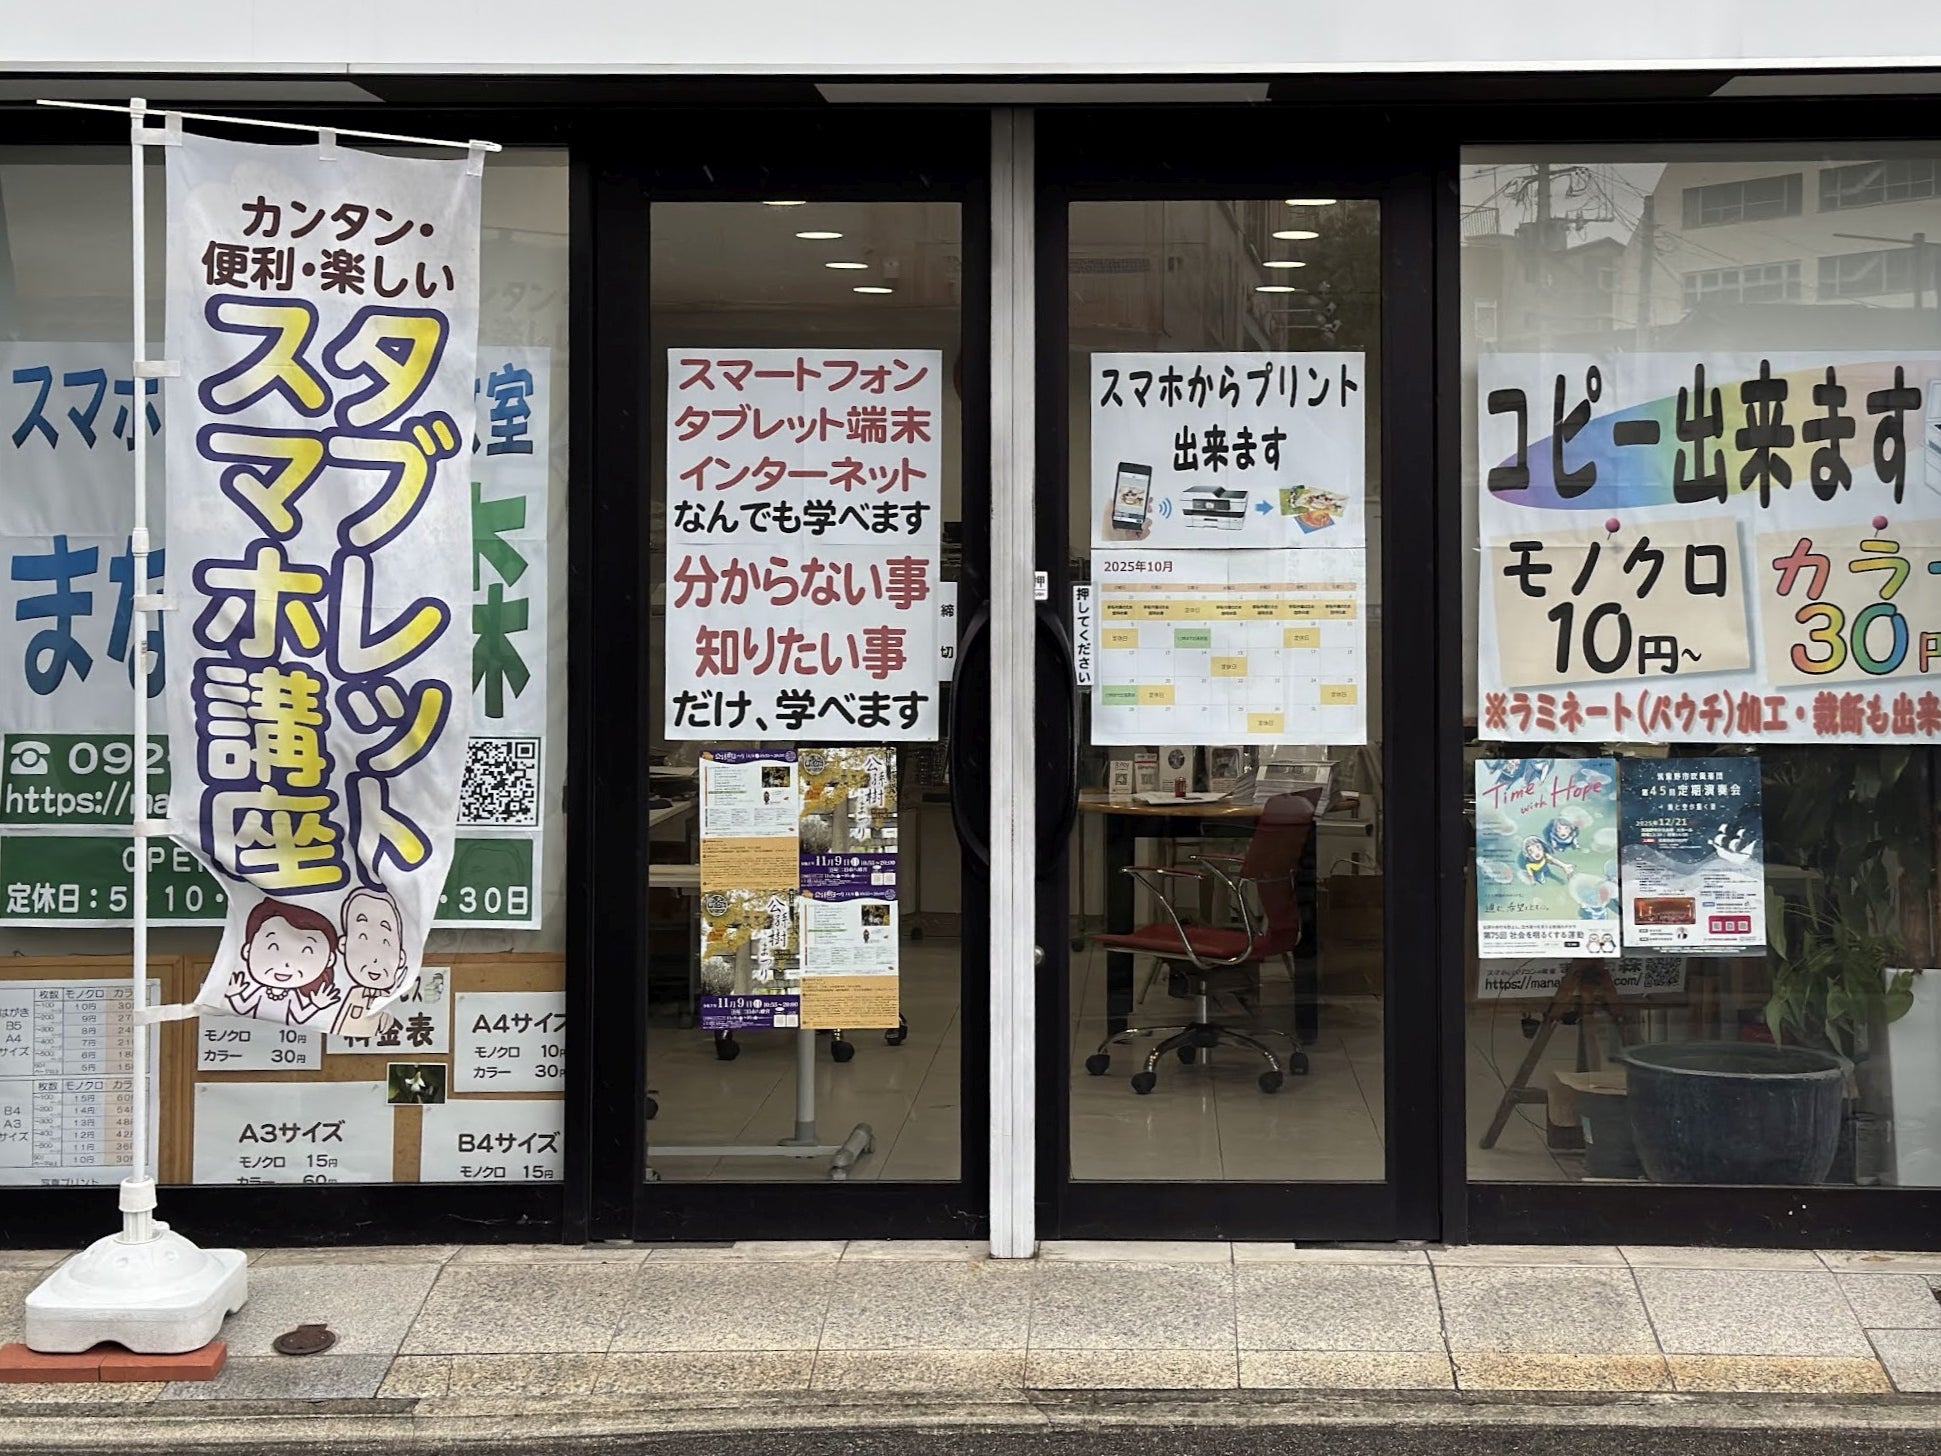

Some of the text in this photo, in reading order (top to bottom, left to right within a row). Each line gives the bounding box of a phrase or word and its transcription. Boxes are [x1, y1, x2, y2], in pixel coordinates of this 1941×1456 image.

[241, 196, 434, 246] カンタン・
[202, 241, 455, 298] 便利・楽しい
[679, 357, 929, 394] スマートフォン
[1100, 361, 1358, 409] スマホからプリント
[674, 403, 931, 444] タブレット端末
[1487, 359, 1922, 509] コピー出来ます
[1173, 424, 1287, 472] 出来ます
[679, 456, 927, 494] インターネット
[673, 499, 931, 536] なんでも学べます
[1104, 561, 1173, 573] 2025年10月
[1503, 537, 1726, 599] モノクロ
[1772, 537, 1941, 601] カラ
[673, 555, 930, 610] 分からない事
[192, 294, 350, 896] スマホ講座
[322, 305, 463, 891] タブレット
[1076, 587, 1092, 684] 押してください
[695, 624, 907, 680] 知りたい事
[672, 689, 929, 731] だけ、学べます
[1482, 775, 1602, 815] Time with Hope
[122, 847, 204, 873] OPE
[65, 989, 105, 999] モノクロ
[6, 1020, 22, 1031] B5
[81, 1015, 97, 1023] 9円
[5, 1033, 22, 1043] A4
[81, 1039, 97, 1047] 7円
[204, 1029, 307, 1044] モノクロ 10円
[203, 1049, 307, 1064] カラー 30円
[474, 1046, 520, 1058] モノクロ
[81, 1063, 133, 1072] 5円 15
[473, 1066, 512, 1079] カラー
[66, 1081, 104, 1090] モノクロ
[117, 1094, 133, 1102] 60
[4, 1106, 21, 1116] B4
[117, 1106, 133, 1114] 54
[3, 1119, 22, 1129] A3
[74, 1119, 95, 1127] 13円
[239, 1119, 346, 1144] A3サイズ
[74, 1131, 95, 1139] 12円
[457, 1131, 561, 1154] B4サイズ
[74, 1156, 95, 1164] 10円
[239, 1154, 338, 1169] モノクロ 15円
[460, 1165, 554, 1179] モノクロ 15円
